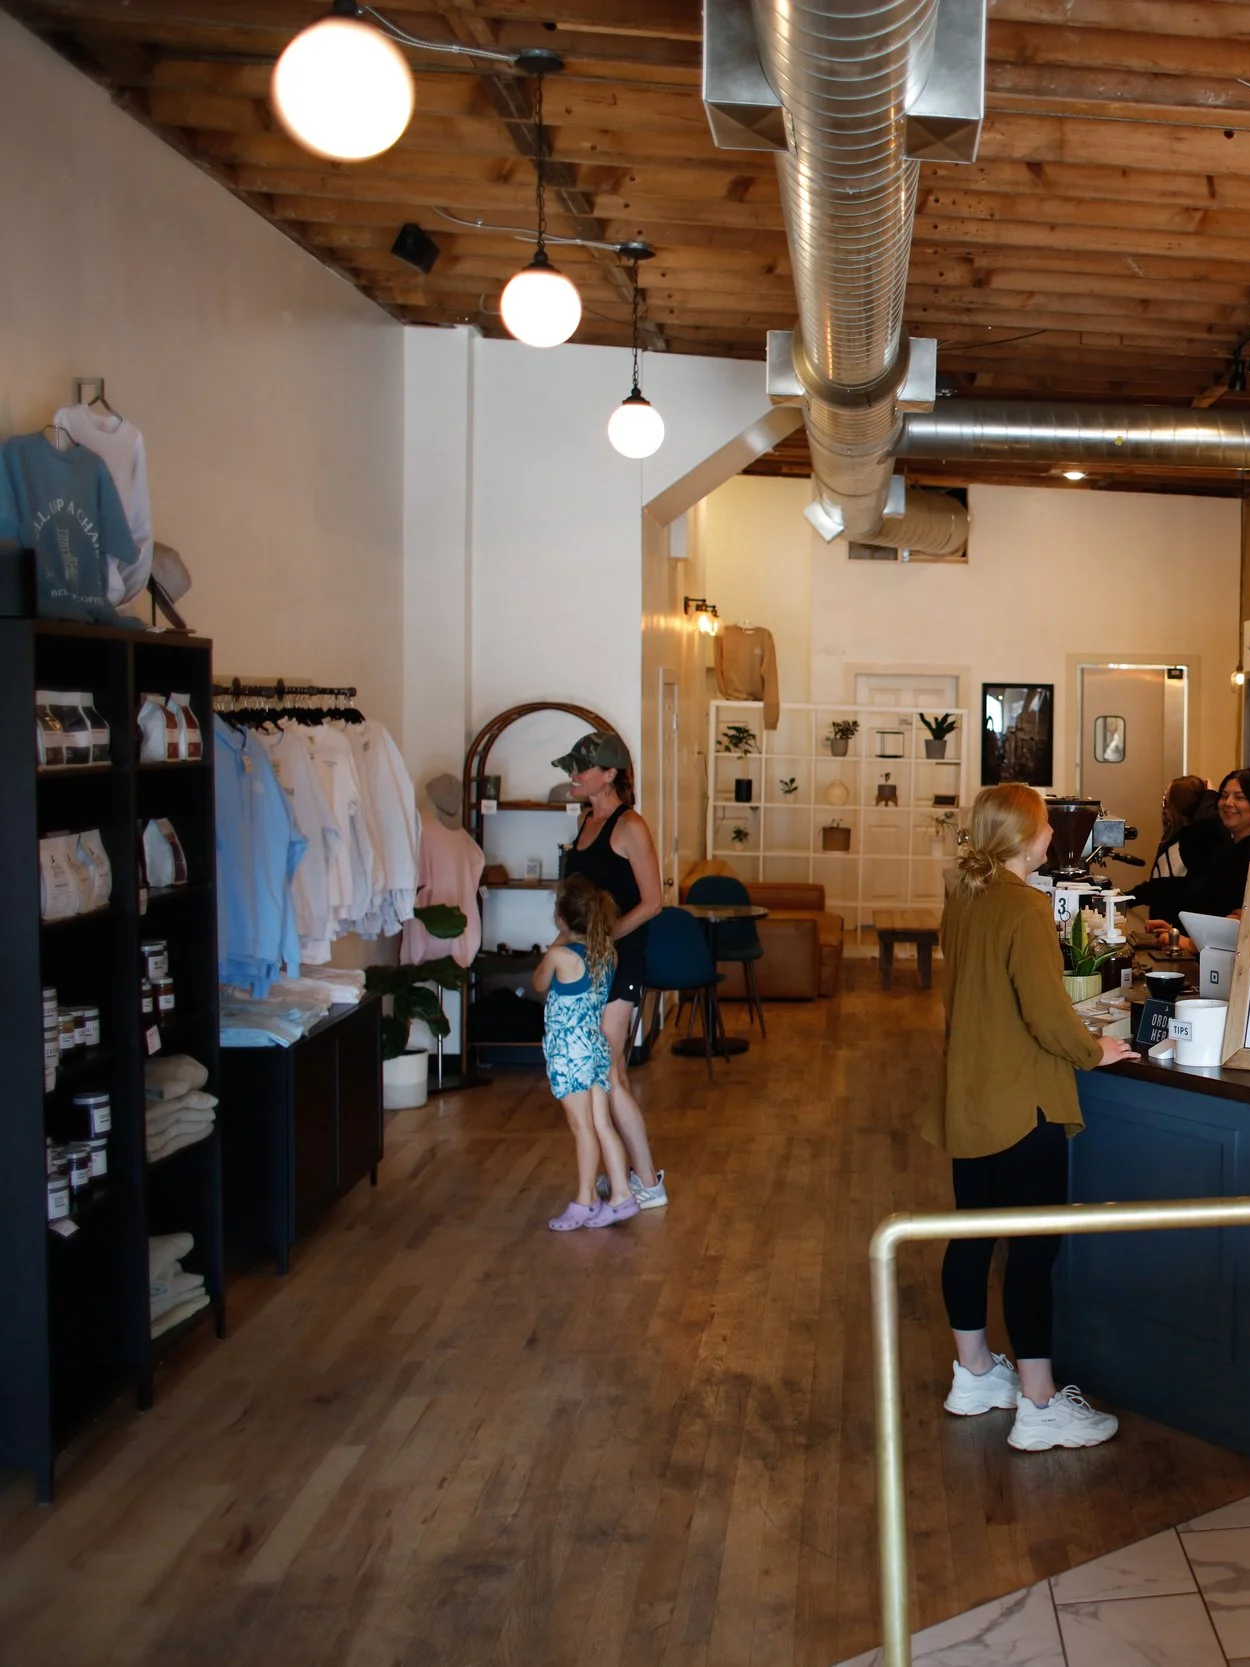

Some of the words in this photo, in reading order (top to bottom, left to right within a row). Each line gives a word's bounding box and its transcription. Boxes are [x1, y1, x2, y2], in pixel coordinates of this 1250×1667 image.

[49, 498, 64, 514] UP
[1058, 897, 1067, 915] 3
[1151, 1013, 1168, 1028] ORD
[1150, 1028, 1167, 1042] HER
[1174, 1025, 1189, 1036] TIPS
